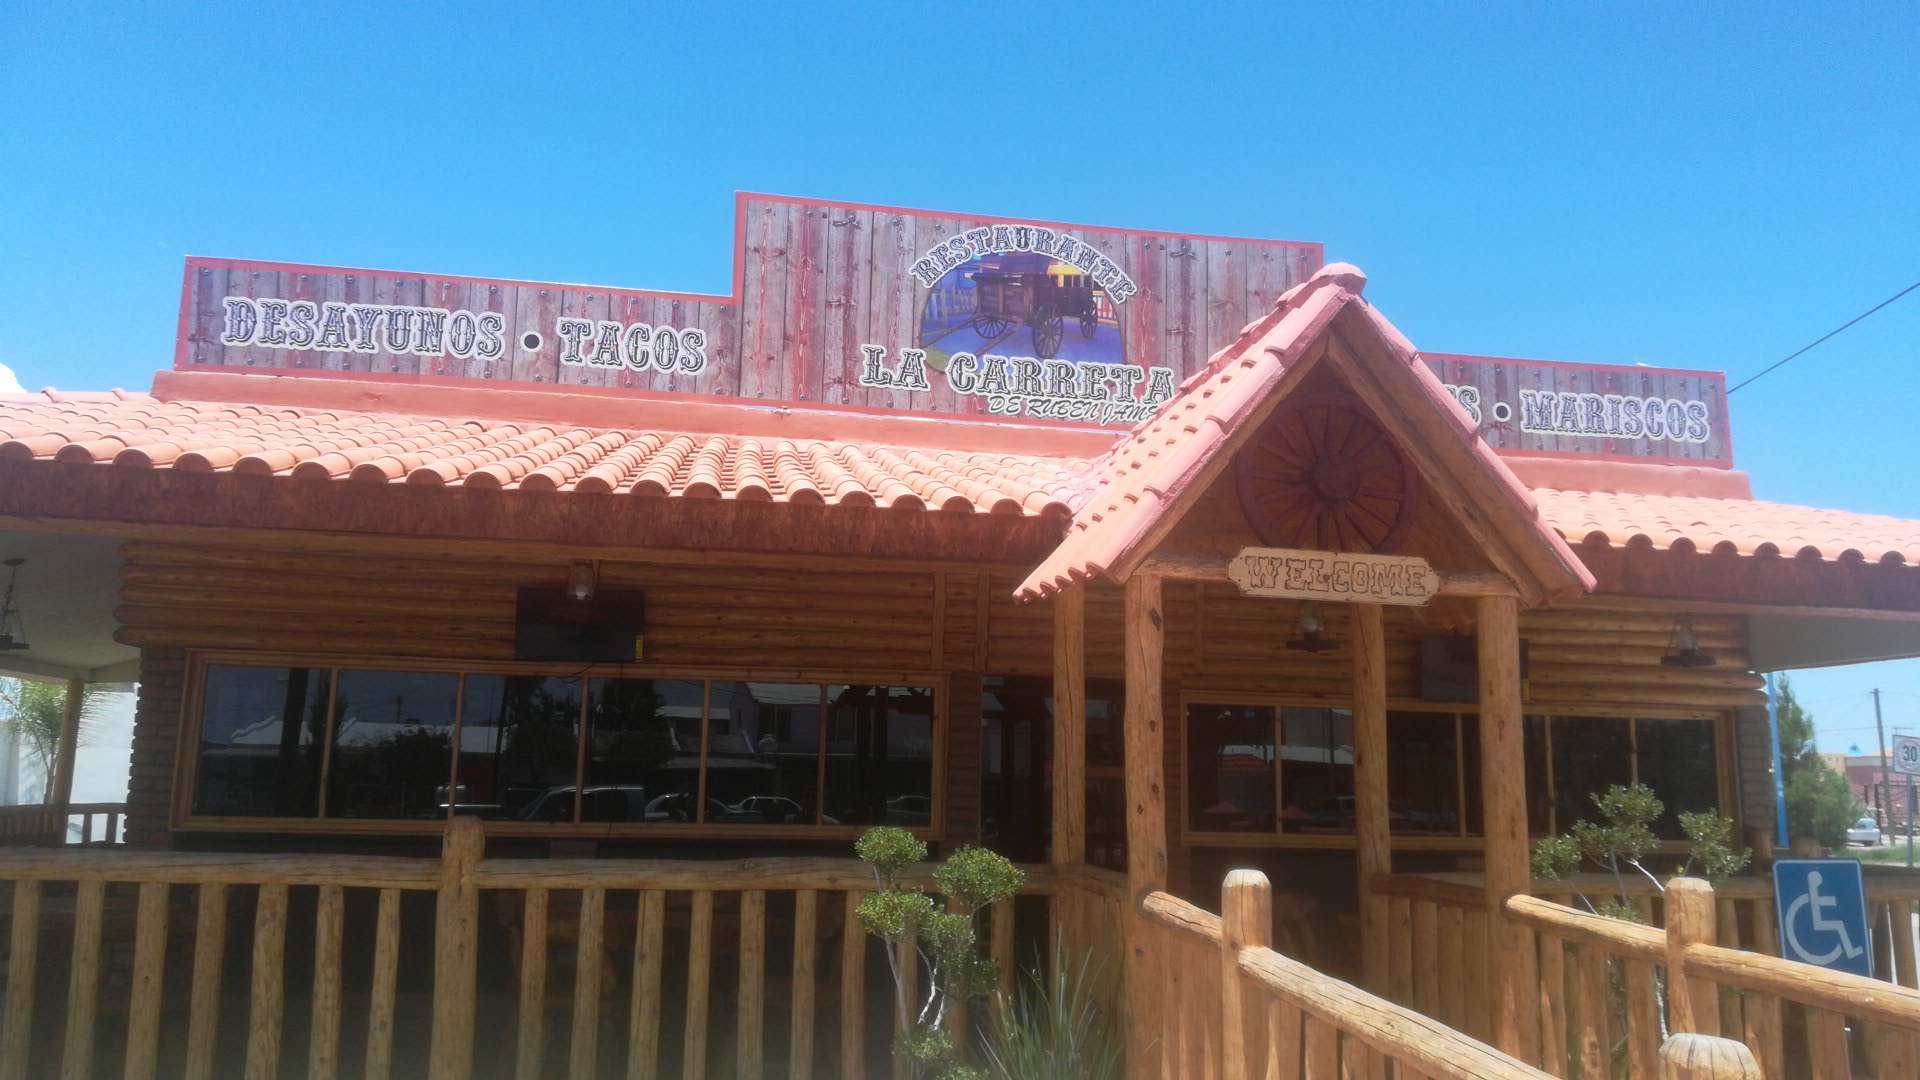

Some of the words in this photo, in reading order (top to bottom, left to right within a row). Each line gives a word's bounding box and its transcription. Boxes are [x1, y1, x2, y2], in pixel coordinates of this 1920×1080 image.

[910, 225, 1136, 303] RESTAURANTE
[222, 297, 503, 359] DESAYUNOS
[558, 318, 708, 375] TACOS
[860, 345, 930, 391] LA
[948, 353, 1176, 404] CARRETA
[988, 394, 1021, 414] DE
[1027, 397, 1099, 419] RUBEN
[1519, 389, 1710, 442] MARISCOS
[1245, 555, 1428, 597] WELCOME
[1903, 744, 1918, 762] 30
